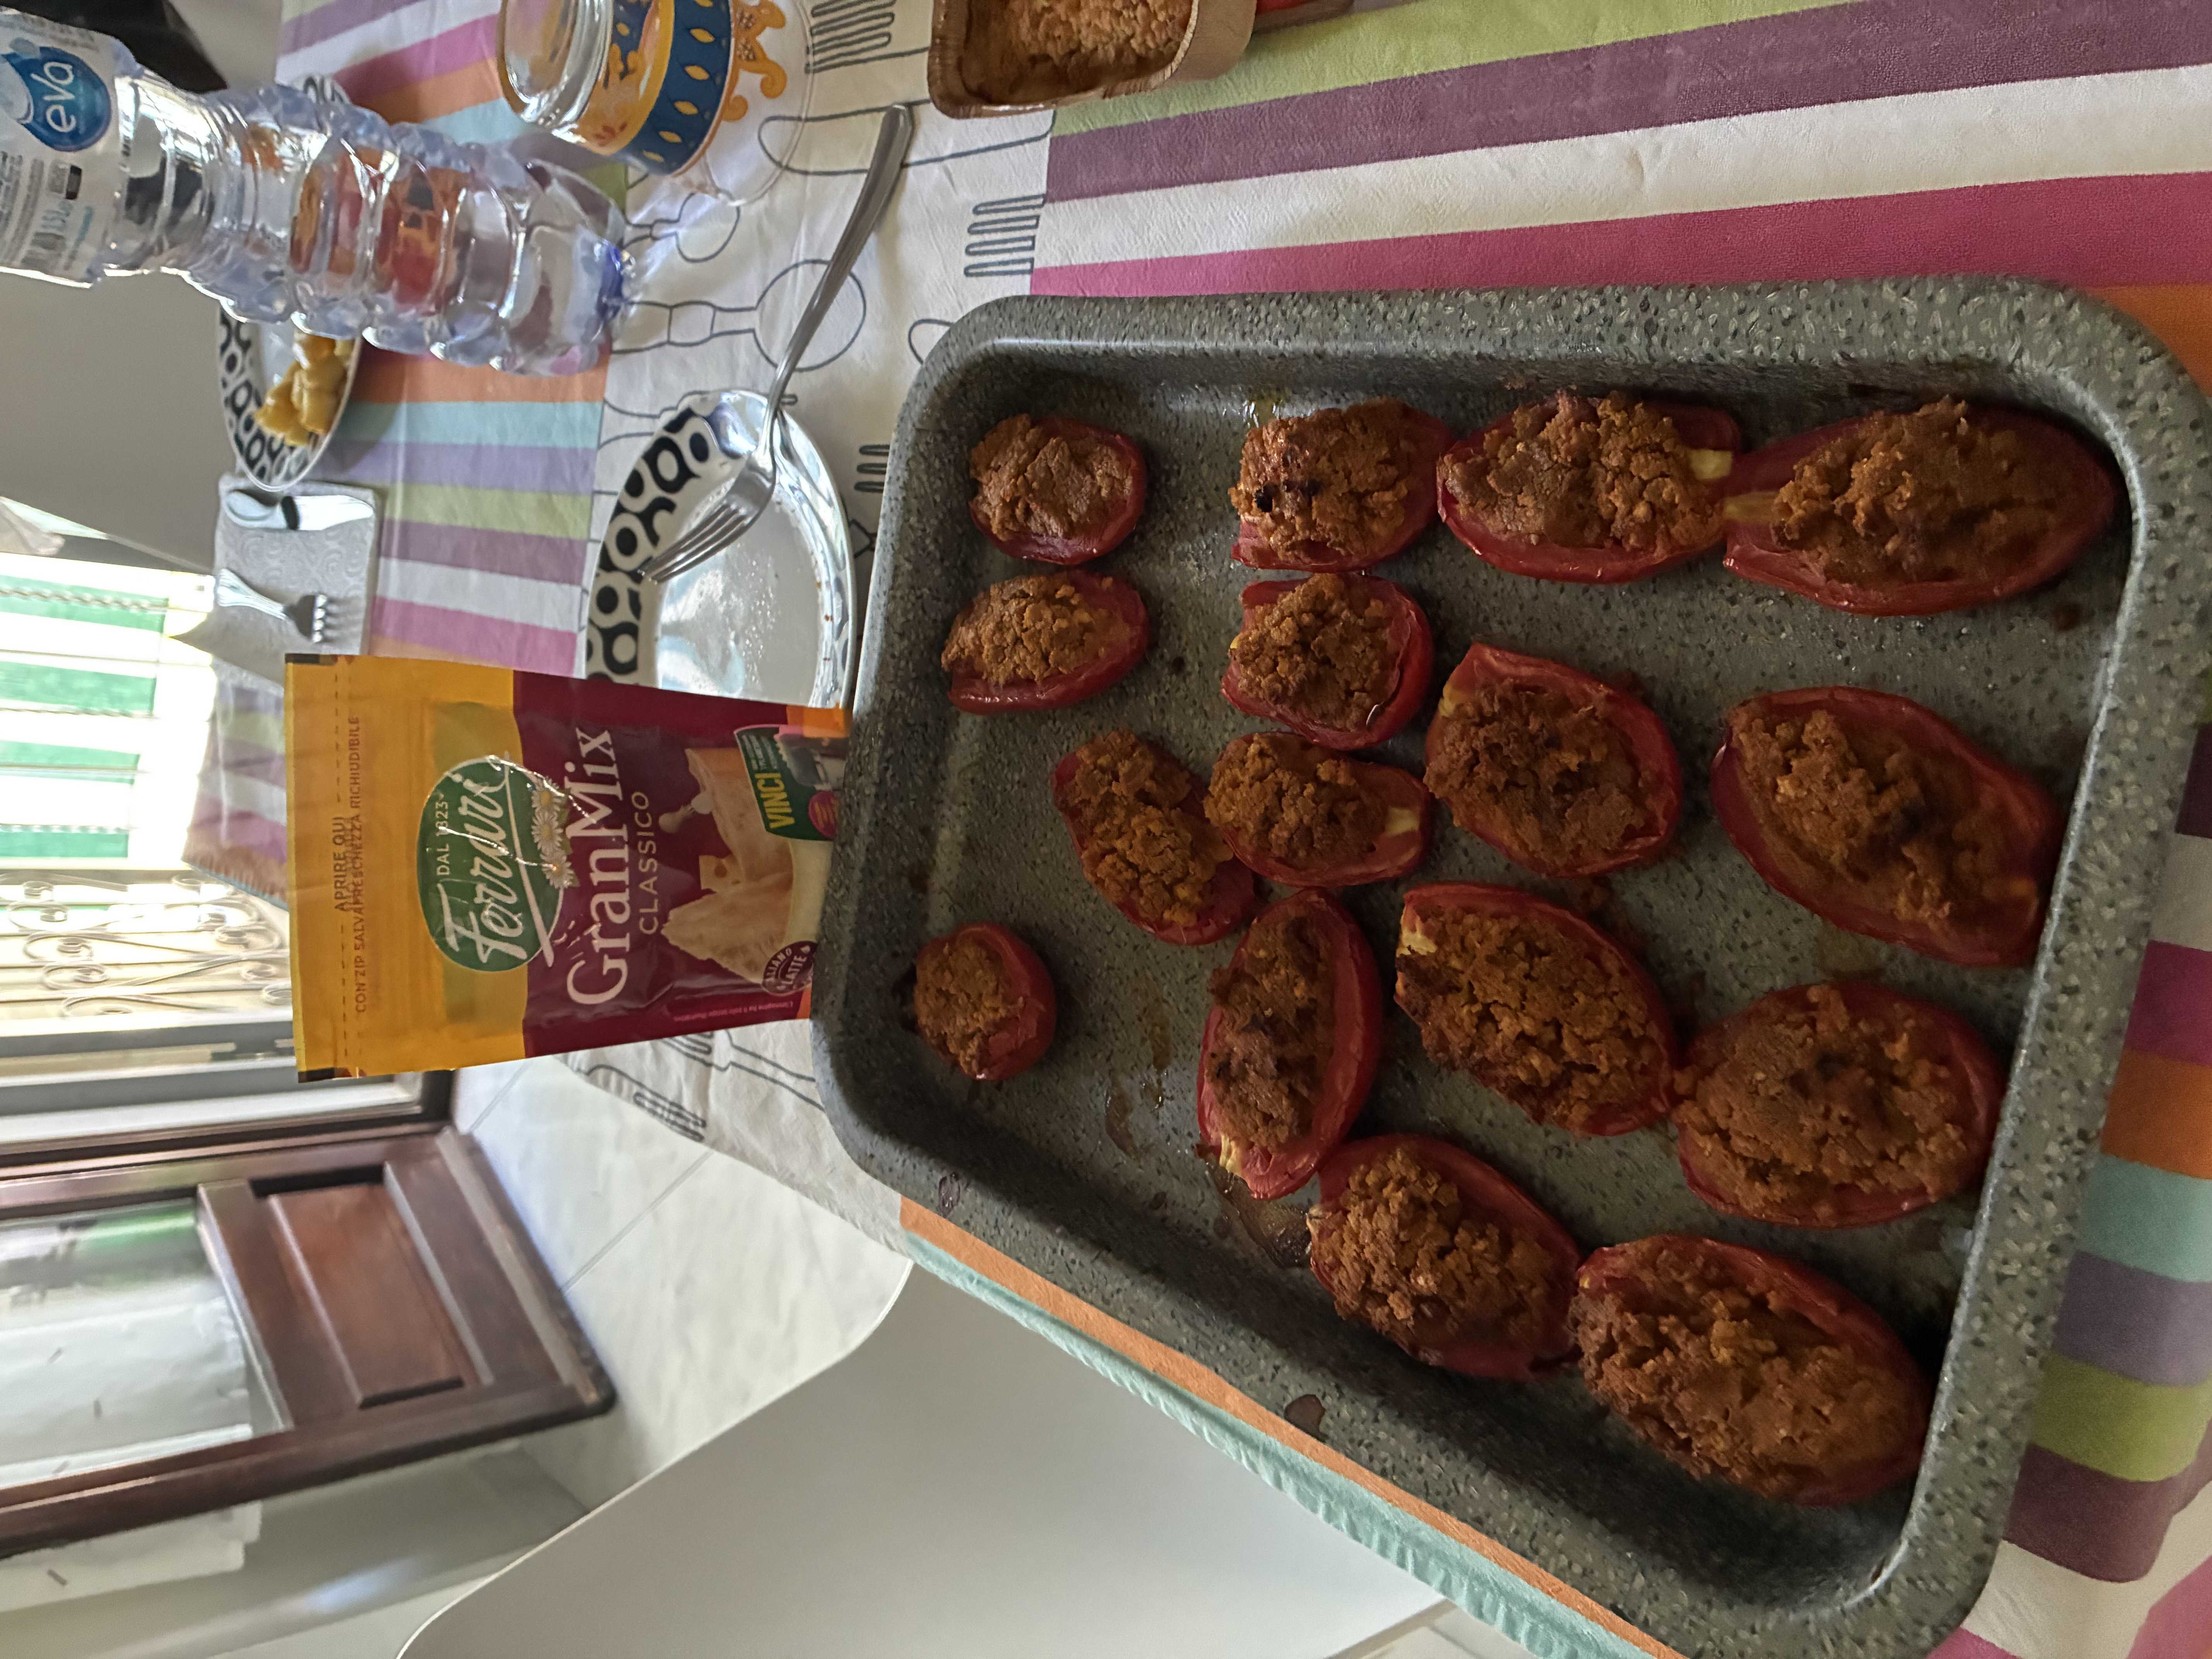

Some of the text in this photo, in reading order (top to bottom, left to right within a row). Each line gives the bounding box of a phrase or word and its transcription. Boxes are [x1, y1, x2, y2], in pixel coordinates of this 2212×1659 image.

[31, 62, 77, 132] eva
[348, 716, 361, 809] RICHIUDIBILE
[435, 801, 450, 876] DAL 1823
[755, 773, 795, 829] VINCI
[332, 816, 348, 912] APRIRE QUI
[436, 771, 529, 964] Ferrari
[564, 727, 630, 1005] GranMix
[631, 792, 659, 935] CLASSICO
[354, 955, 366, 977] ZIP
[355, 981, 366, 1013] CON
[780, 955, 807, 985] LATTE
